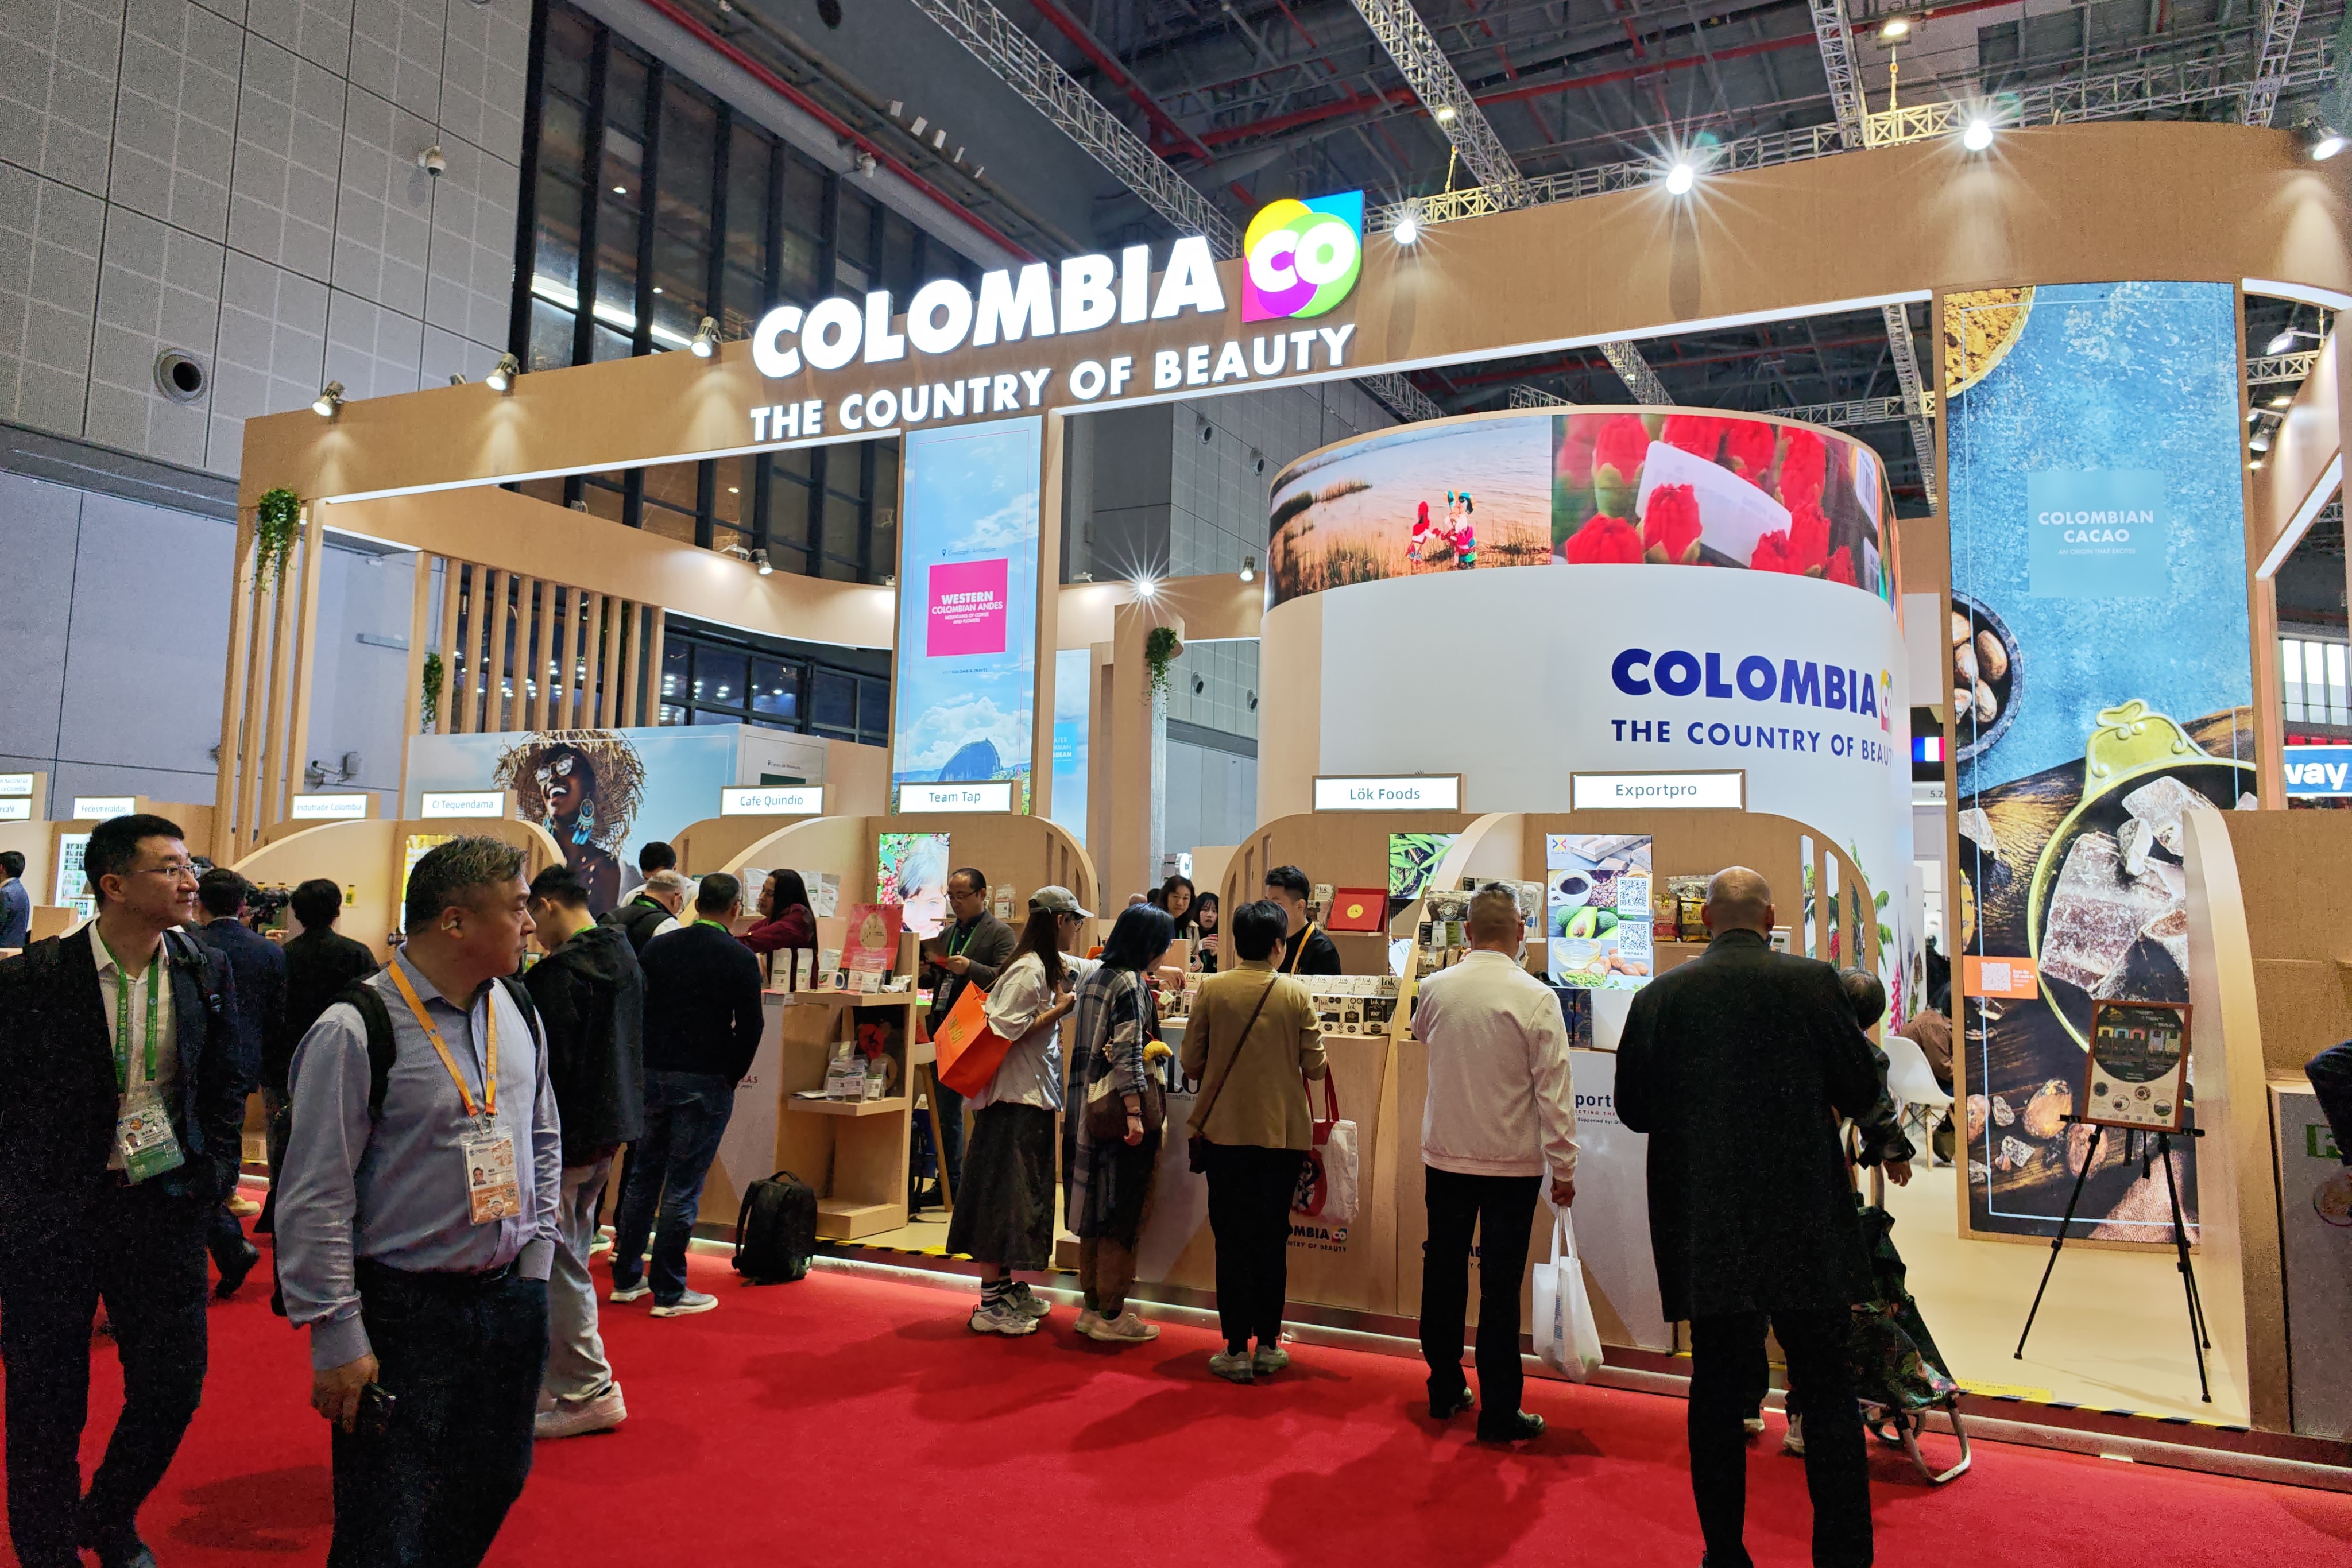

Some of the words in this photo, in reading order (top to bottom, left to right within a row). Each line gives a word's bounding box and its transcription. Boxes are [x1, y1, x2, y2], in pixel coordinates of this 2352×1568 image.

[751, 236, 1227, 379] COLOMBIA
[750, 398, 822, 442] THE
[840, 367, 1051, 429] COUNTRY
[1069, 356, 1132, 401] OF
[1154, 324, 1356, 390] BEAUTY
[2038, 510, 2154, 525] COLOMBIAN
[2063, 529, 2130, 543] CACAO
[941, 591, 993, 605] WESTERN
[931, 604, 976, 614] COLOMBIAN
[977, 601, 1003, 610] ANDES
[1611, 648, 1878, 718] COLOMBIA
[1611, 719, 1670, 743] THE
[1687, 722, 1821, 753] COUNTRY
[1831, 734, 1854, 757] OF
[2284, 762, 2349, 791] vay
[929, 792, 958, 802] Team
[962, 792, 981, 804] Tap
[1350, 788, 1374, 800] Lök
[1379, 787, 1420, 800] Foods
[1616, 784, 1697, 799] Exportpro
[1929, 790, 1946, 799] 5.2
[331, 803, 362, 811] Colombia
[442, 800, 493, 810] Tequendama
[740, 795, 761, 806] Café
[764, 795, 803, 807] Quindío
[81, 805, 126, 813] Fedesmeraldas
[1292, 1225, 1329, 1240] MBIA
[1320, 1244, 1347, 1252] BEAUTY
